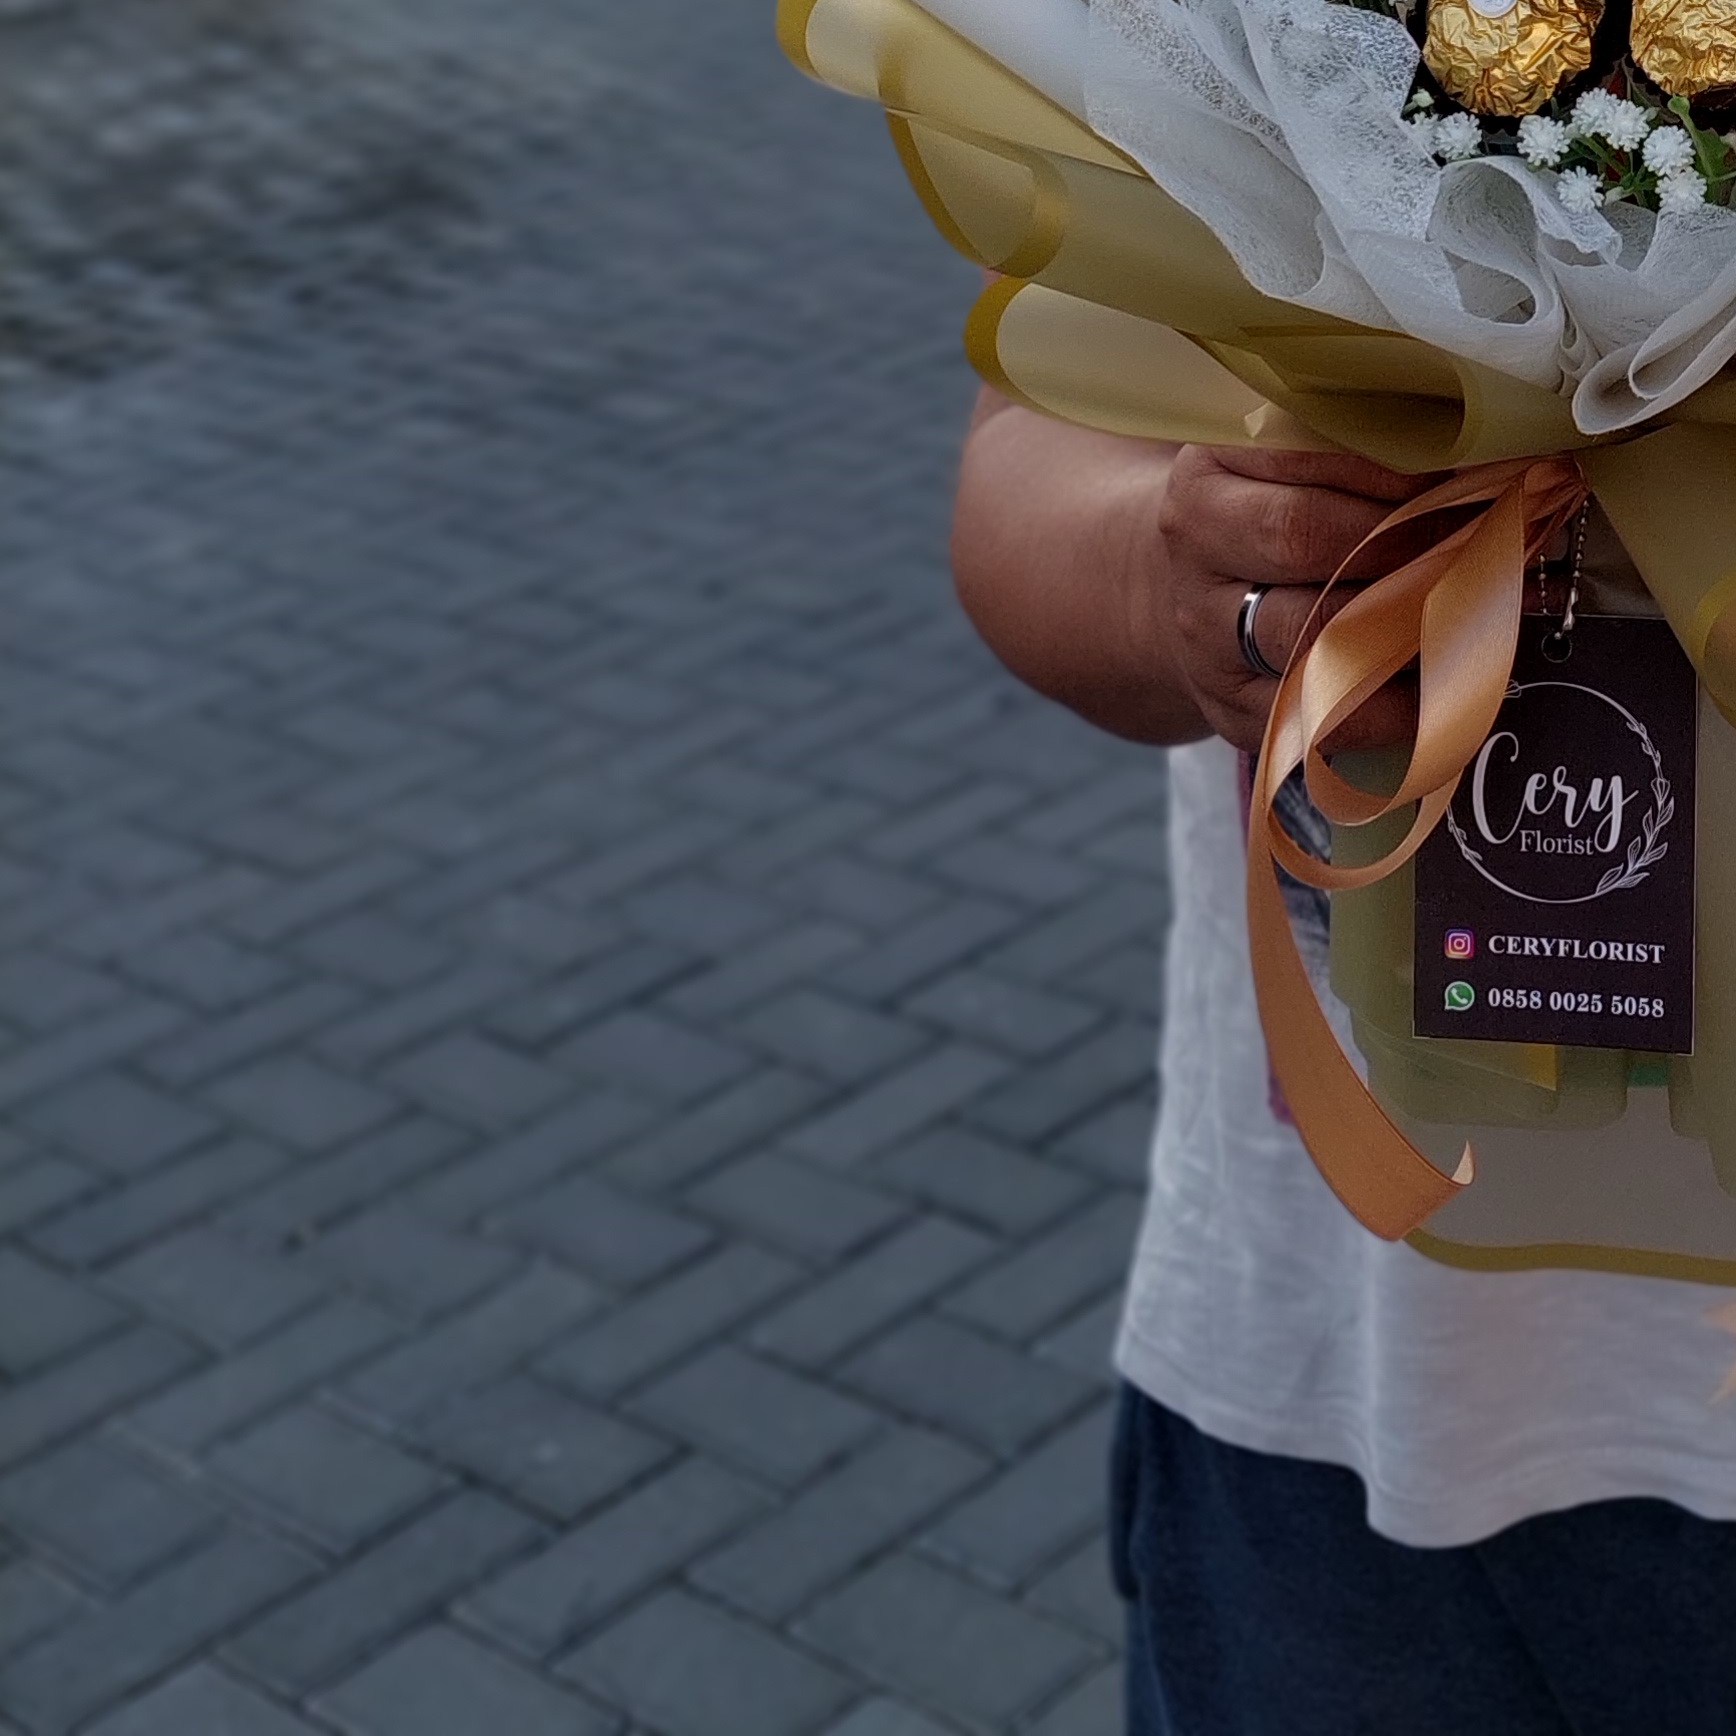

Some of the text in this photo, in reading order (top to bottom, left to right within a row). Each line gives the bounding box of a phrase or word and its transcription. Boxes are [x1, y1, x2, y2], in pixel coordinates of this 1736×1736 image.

[1472, 731, 1639, 853] Cery
[1519, 830, 1594, 855] Florist
[1488, 934, 1665, 964] CERYFLORIST
[1487, 987, 1665, 1018] 0858 0025 5058
